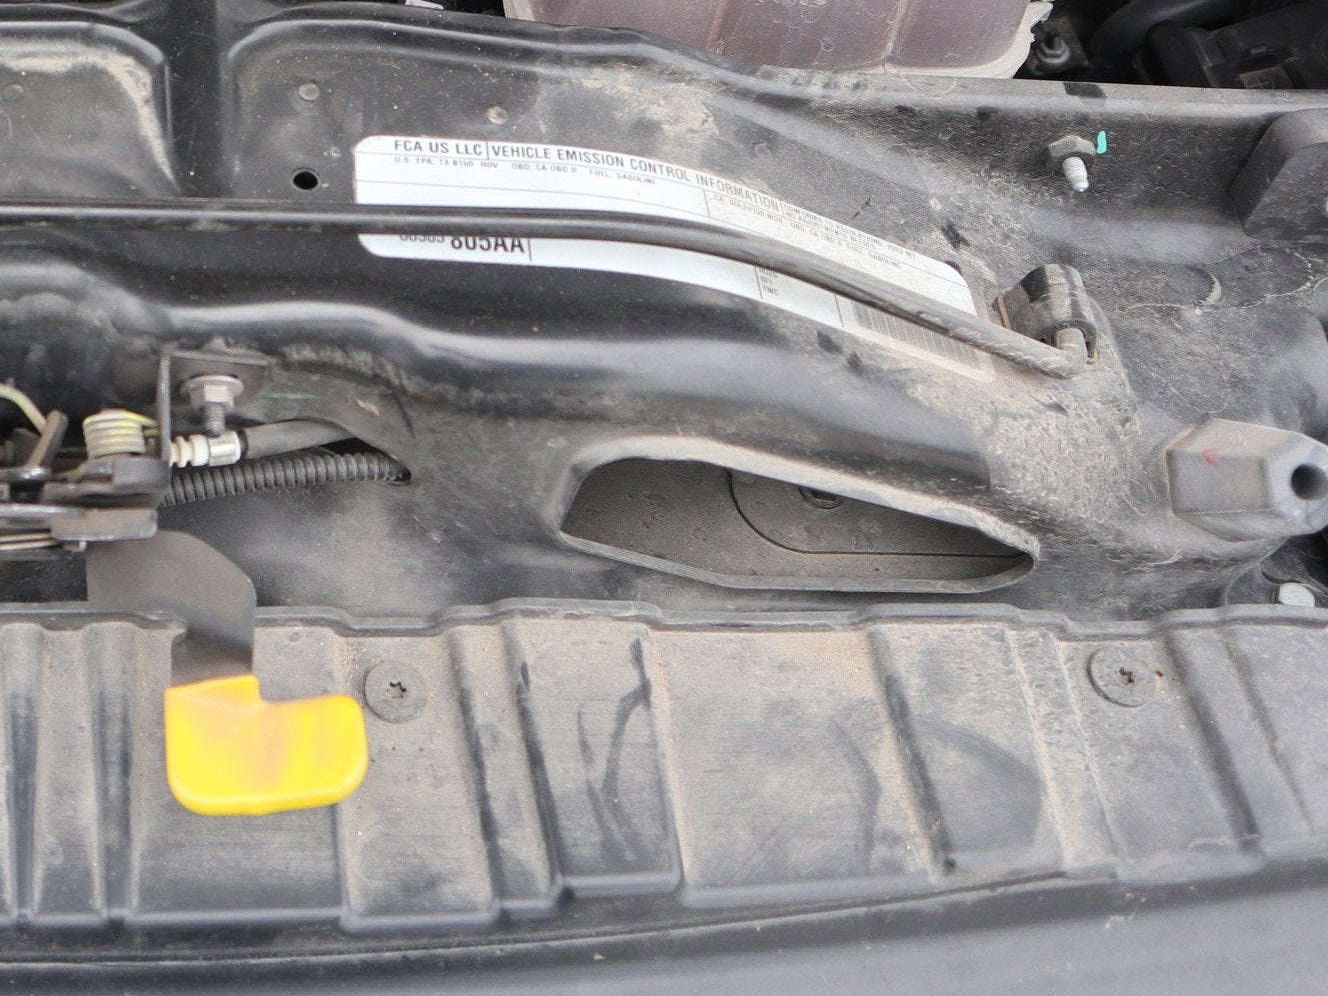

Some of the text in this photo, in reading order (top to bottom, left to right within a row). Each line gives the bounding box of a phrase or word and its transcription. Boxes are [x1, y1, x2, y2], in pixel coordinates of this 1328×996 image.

[394, 139, 781, 212] FCA US LLC VEHICLE EMISSION CONTROL INFORMATION
